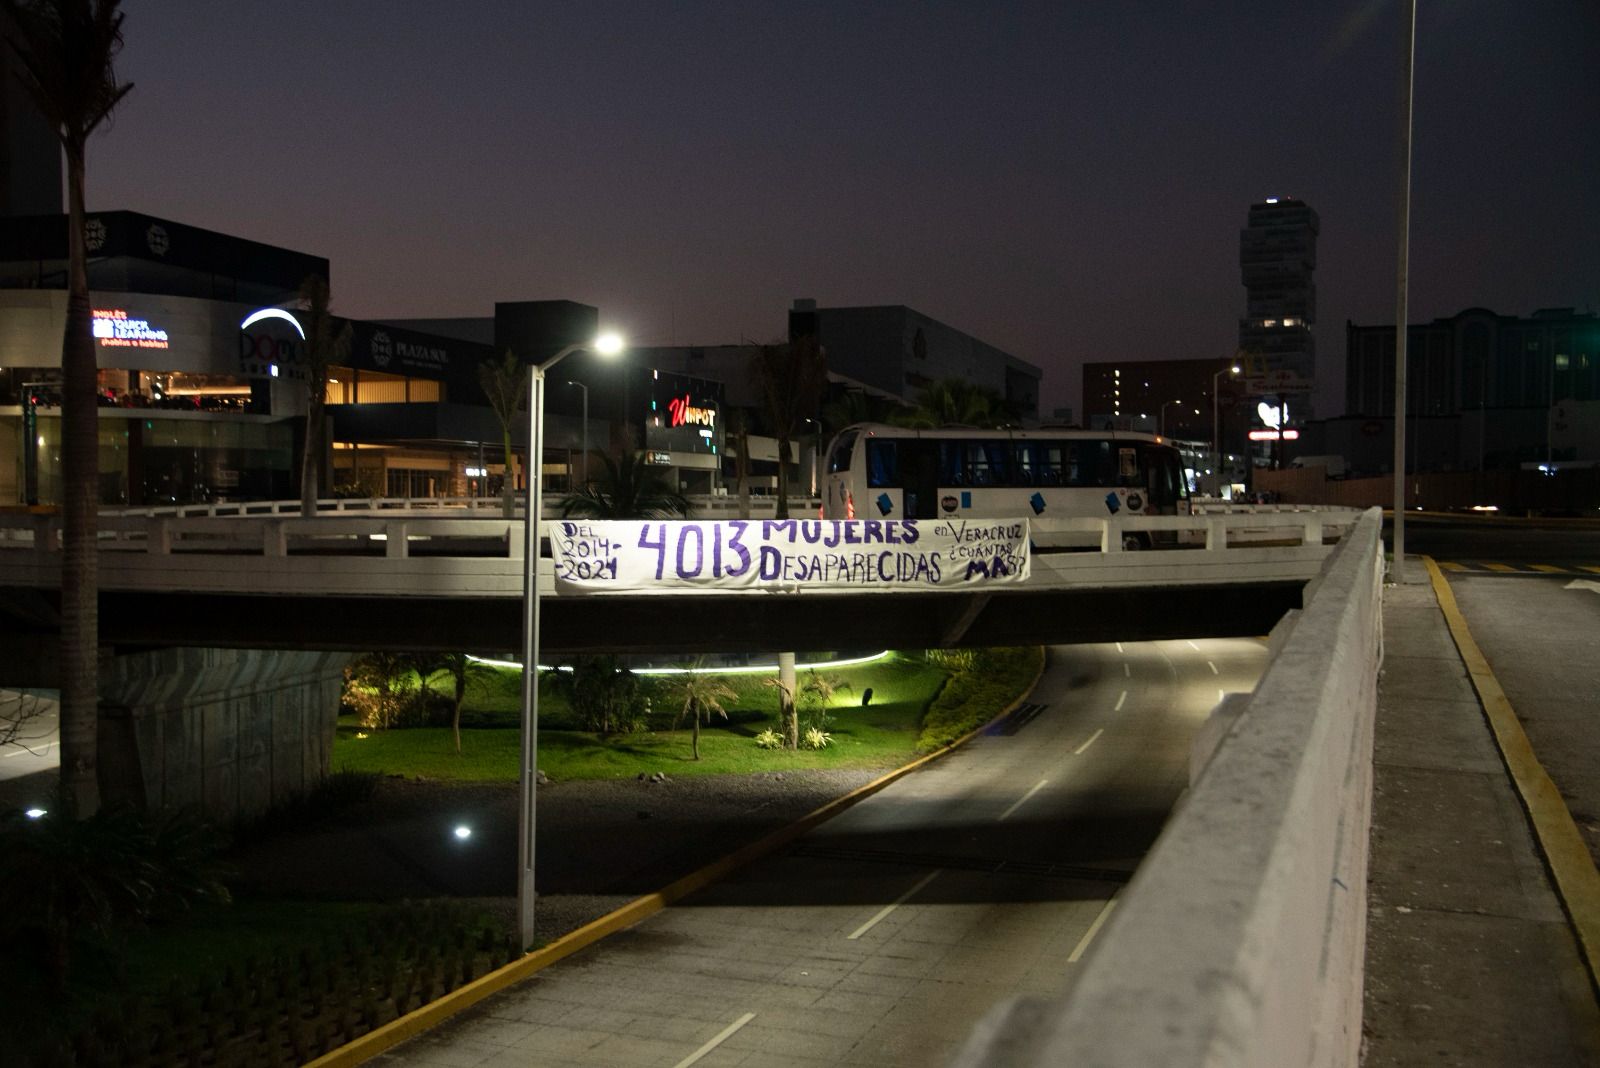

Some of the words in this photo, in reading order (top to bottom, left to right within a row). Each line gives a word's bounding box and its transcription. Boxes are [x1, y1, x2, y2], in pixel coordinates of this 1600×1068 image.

[113, 319, 149, 331] QUICK
[562, 522, 598, 537] DEL
[762, 520, 920, 547] MUJERES
[935, 526, 947, 537] en
[947, 520, 1022, 543] VERACRUZ
[638, 521, 751, 580] 4013
[760, 545, 942, 583] DESAPARECIDAS
